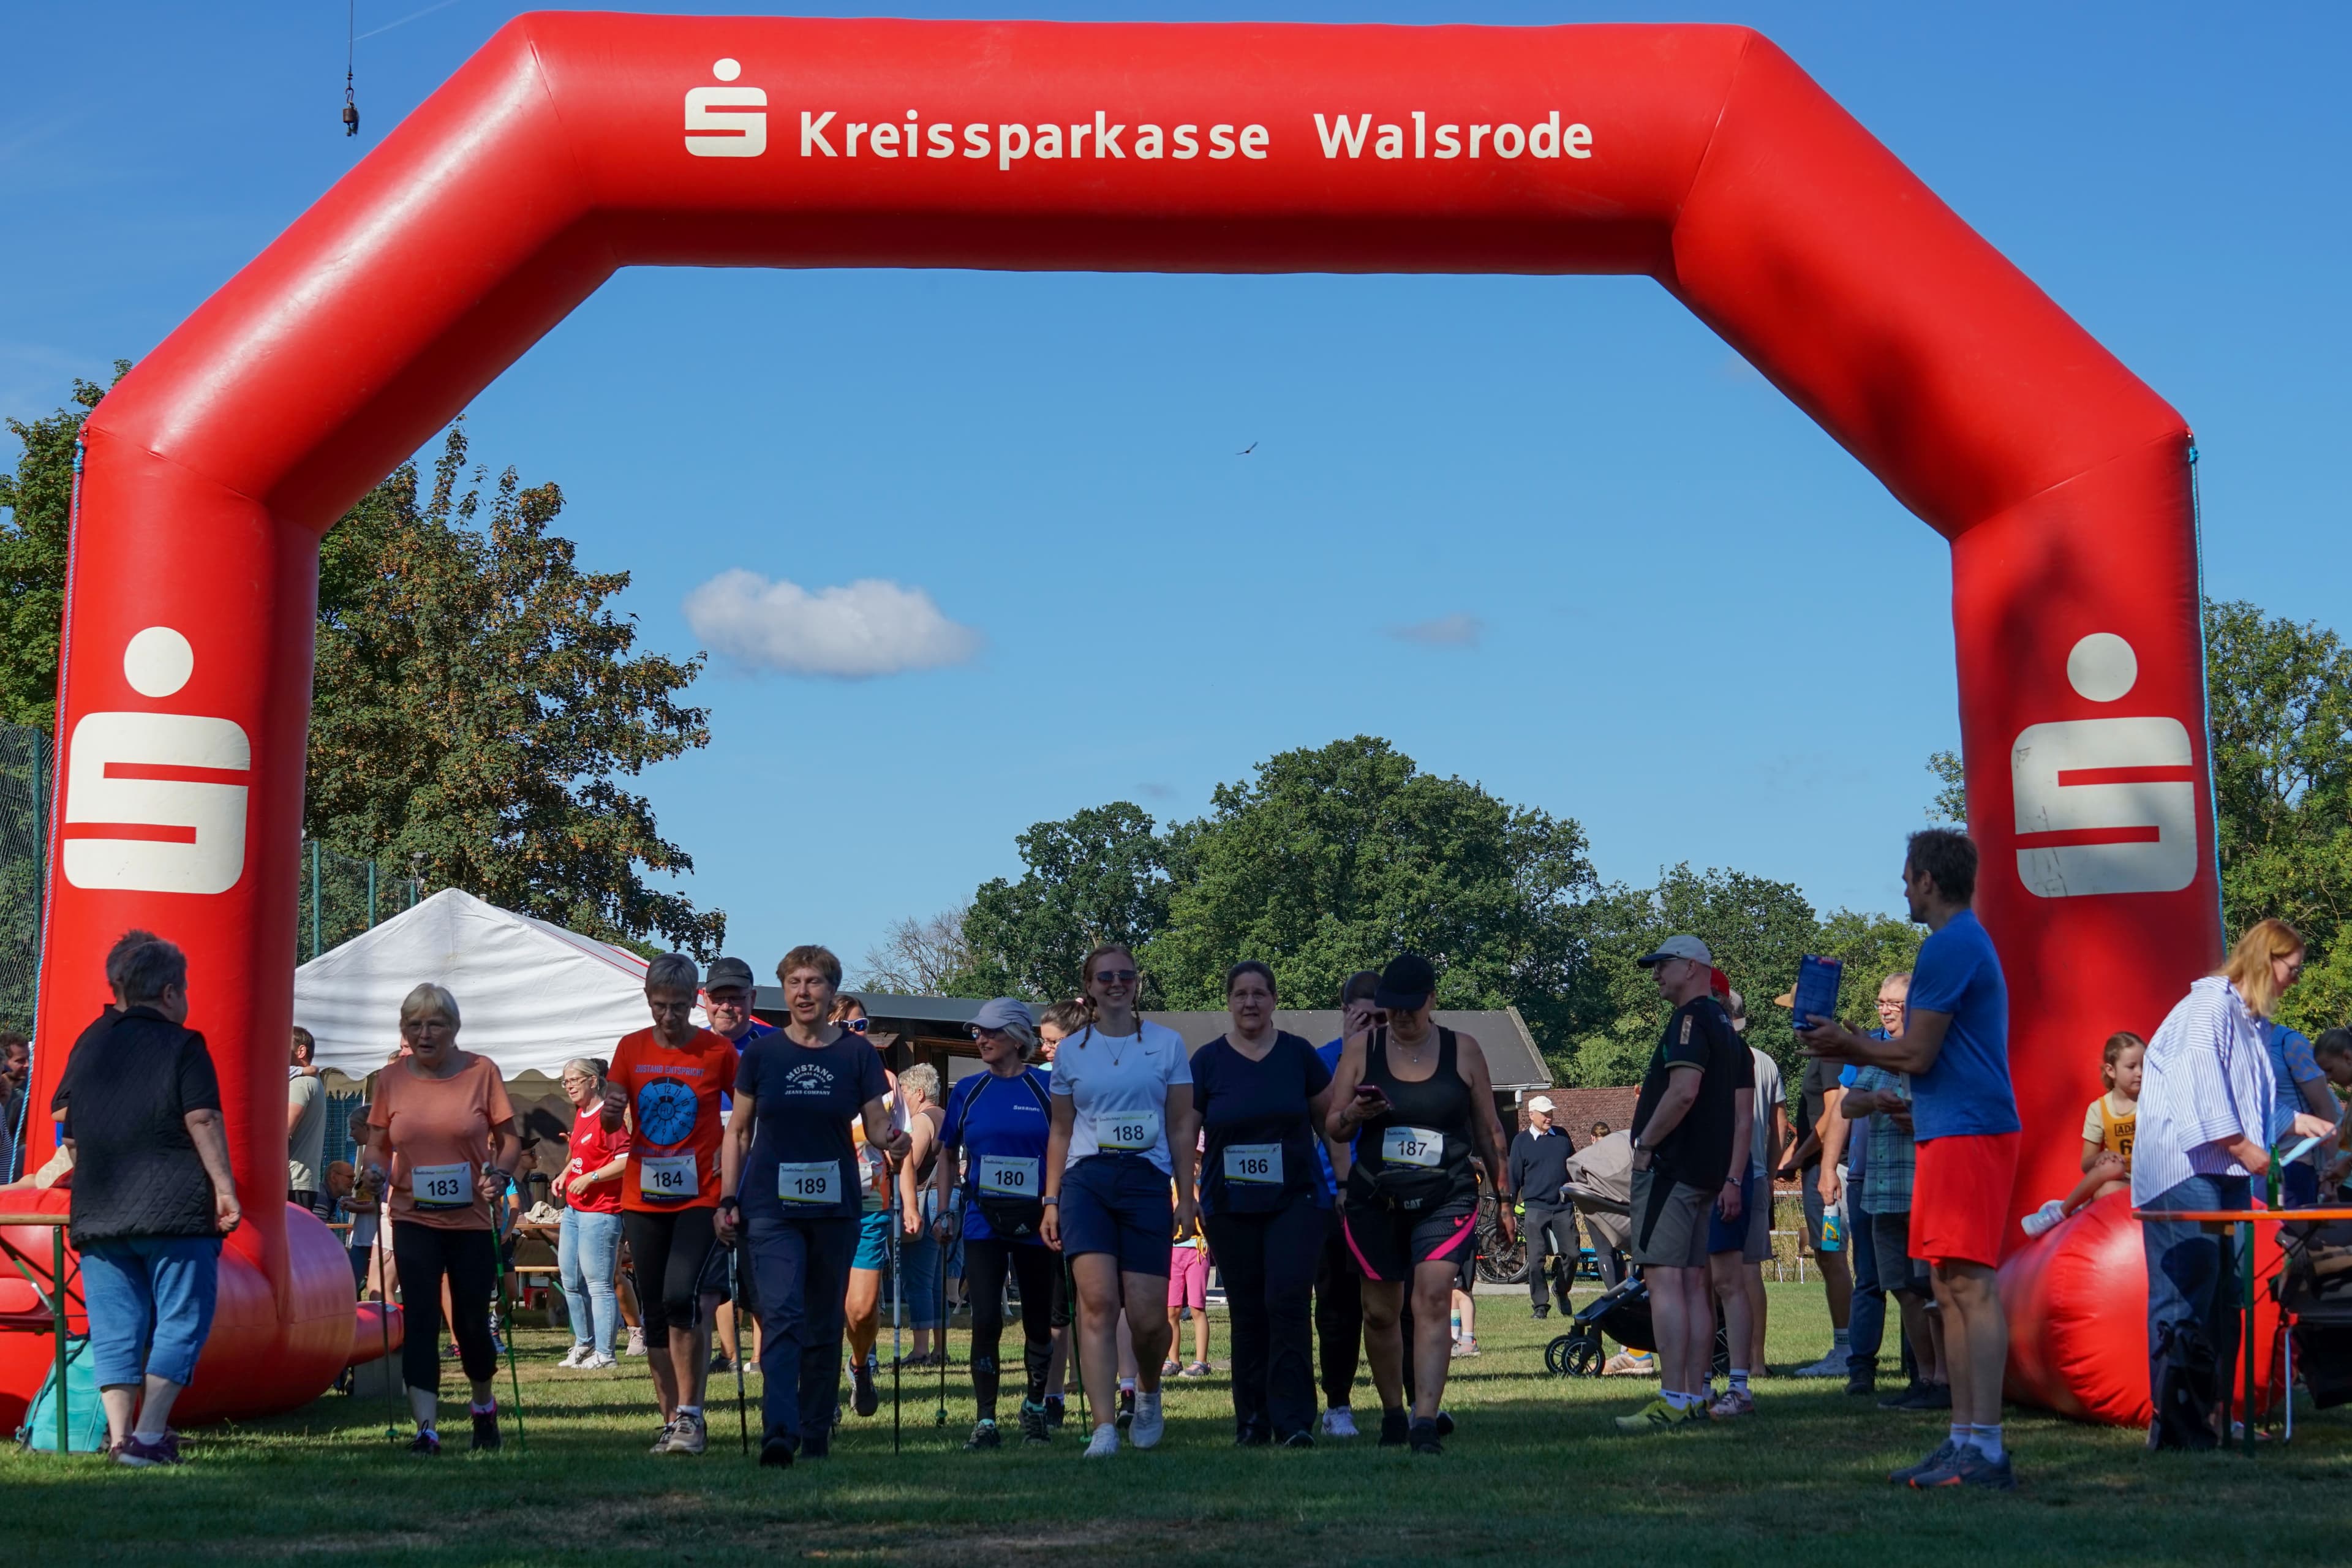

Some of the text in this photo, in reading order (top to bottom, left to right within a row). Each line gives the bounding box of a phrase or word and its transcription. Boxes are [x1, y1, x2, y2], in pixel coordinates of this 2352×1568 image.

[801, 108, 1270, 171] Kreissparkasse
[1313, 110, 1594, 160] Walsrode
[635, 1065, 705, 1078] ZUSTAND ENTSPRICHT
[785, 1064, 834, 1082] MUSTANG
[664, 1085, 671, 1094] 12
[1113, 1125, 1145, 1142] 188
[1397, 1140, 1428, 1156] 187
[1238, 1158, 1268, 1175] 186
[652, 1170, 684, 1188] 184
[794, 1177, 826, 1194] 189
[994, 1170, 1025, 1186] 180
[427, 1179, 459, 1196] 183
[1403, 1198, 1421, 1210] CAT
